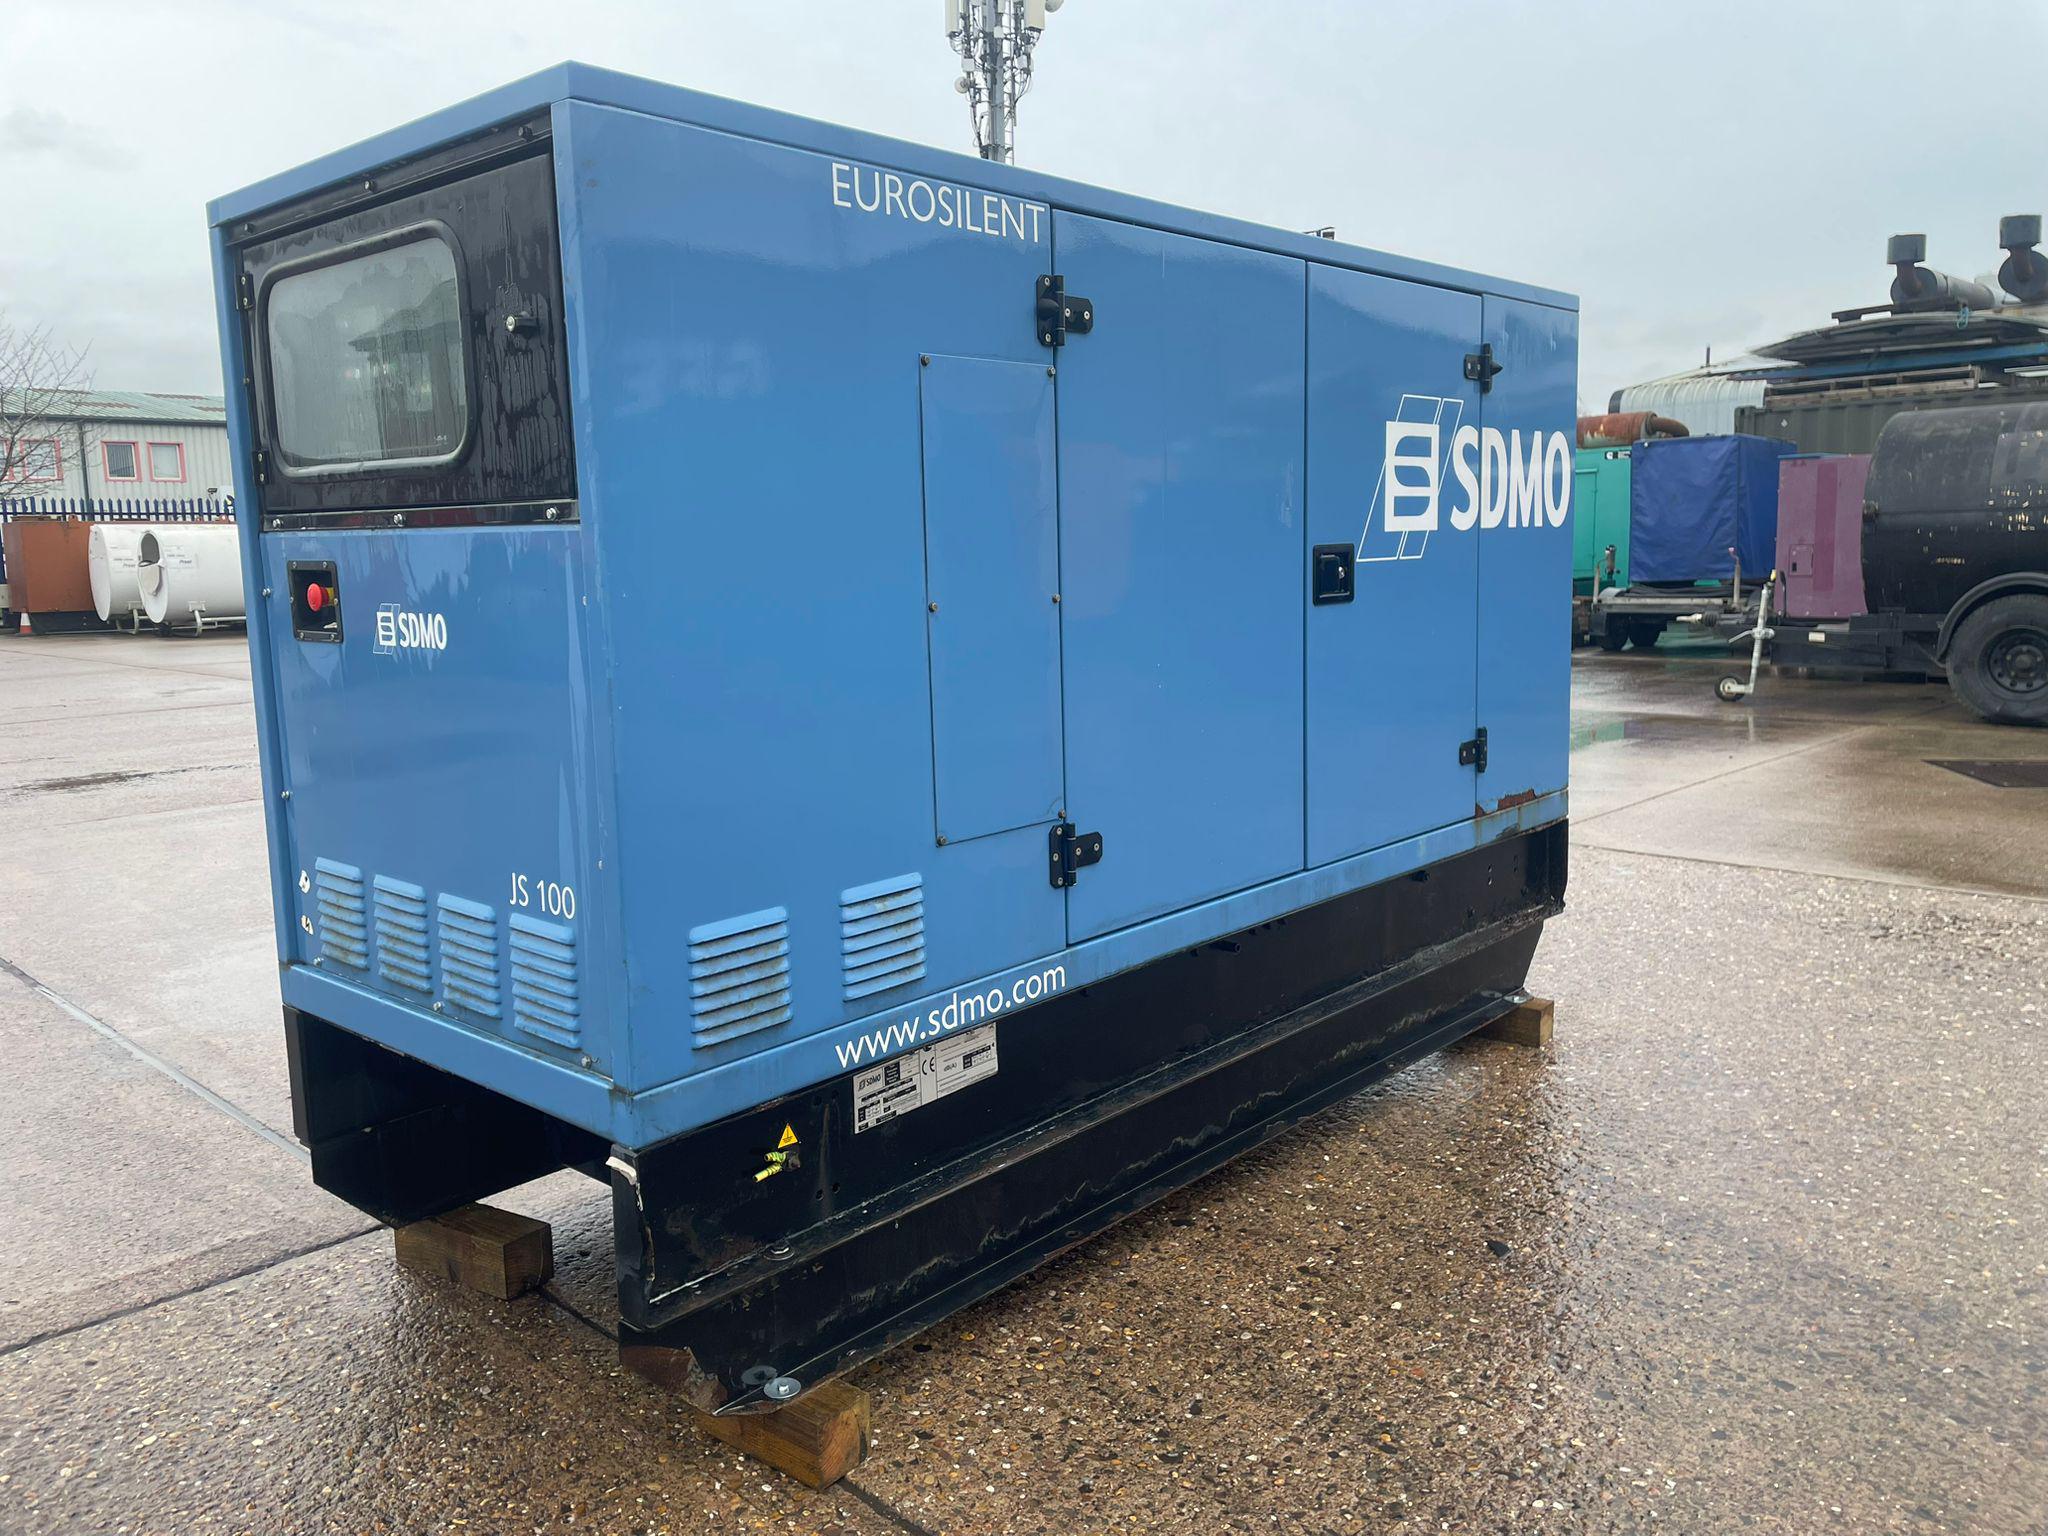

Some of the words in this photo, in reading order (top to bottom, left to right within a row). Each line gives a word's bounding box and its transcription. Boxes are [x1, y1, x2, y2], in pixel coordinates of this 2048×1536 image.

[832, 162, 1045, 243] EUROSILENT
[1450, 425, 1571, 531] SDMO
[398, 611, 447, 650] SDMO
[509, 872, 529, 907] JS
[536, 879, 576, 920] 100
[835, 965, 1066, 1069] www.sdmo.com
